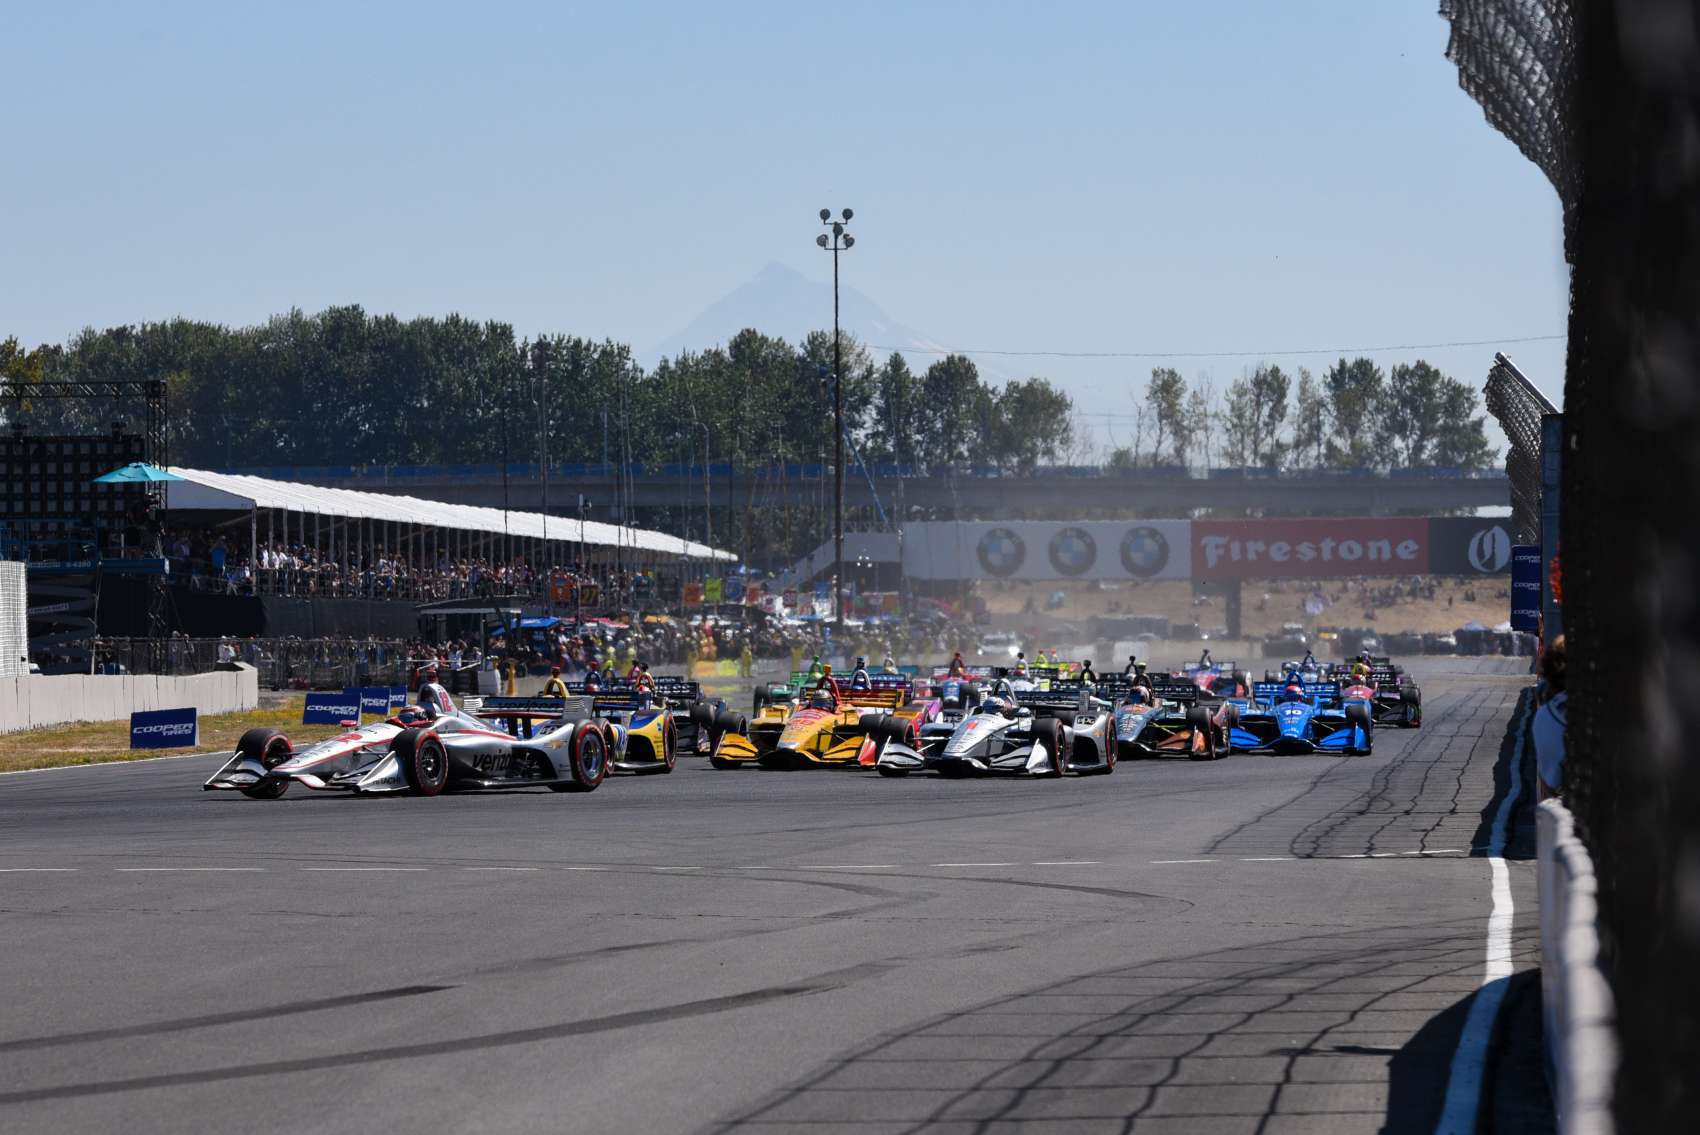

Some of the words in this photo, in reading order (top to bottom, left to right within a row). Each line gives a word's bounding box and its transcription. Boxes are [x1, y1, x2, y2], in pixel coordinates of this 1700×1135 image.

[1201, 535, 1420, 569] Firestone
[1077, 715, 1096, 725] PPG
[133, 723, 194, 734] COOPER
